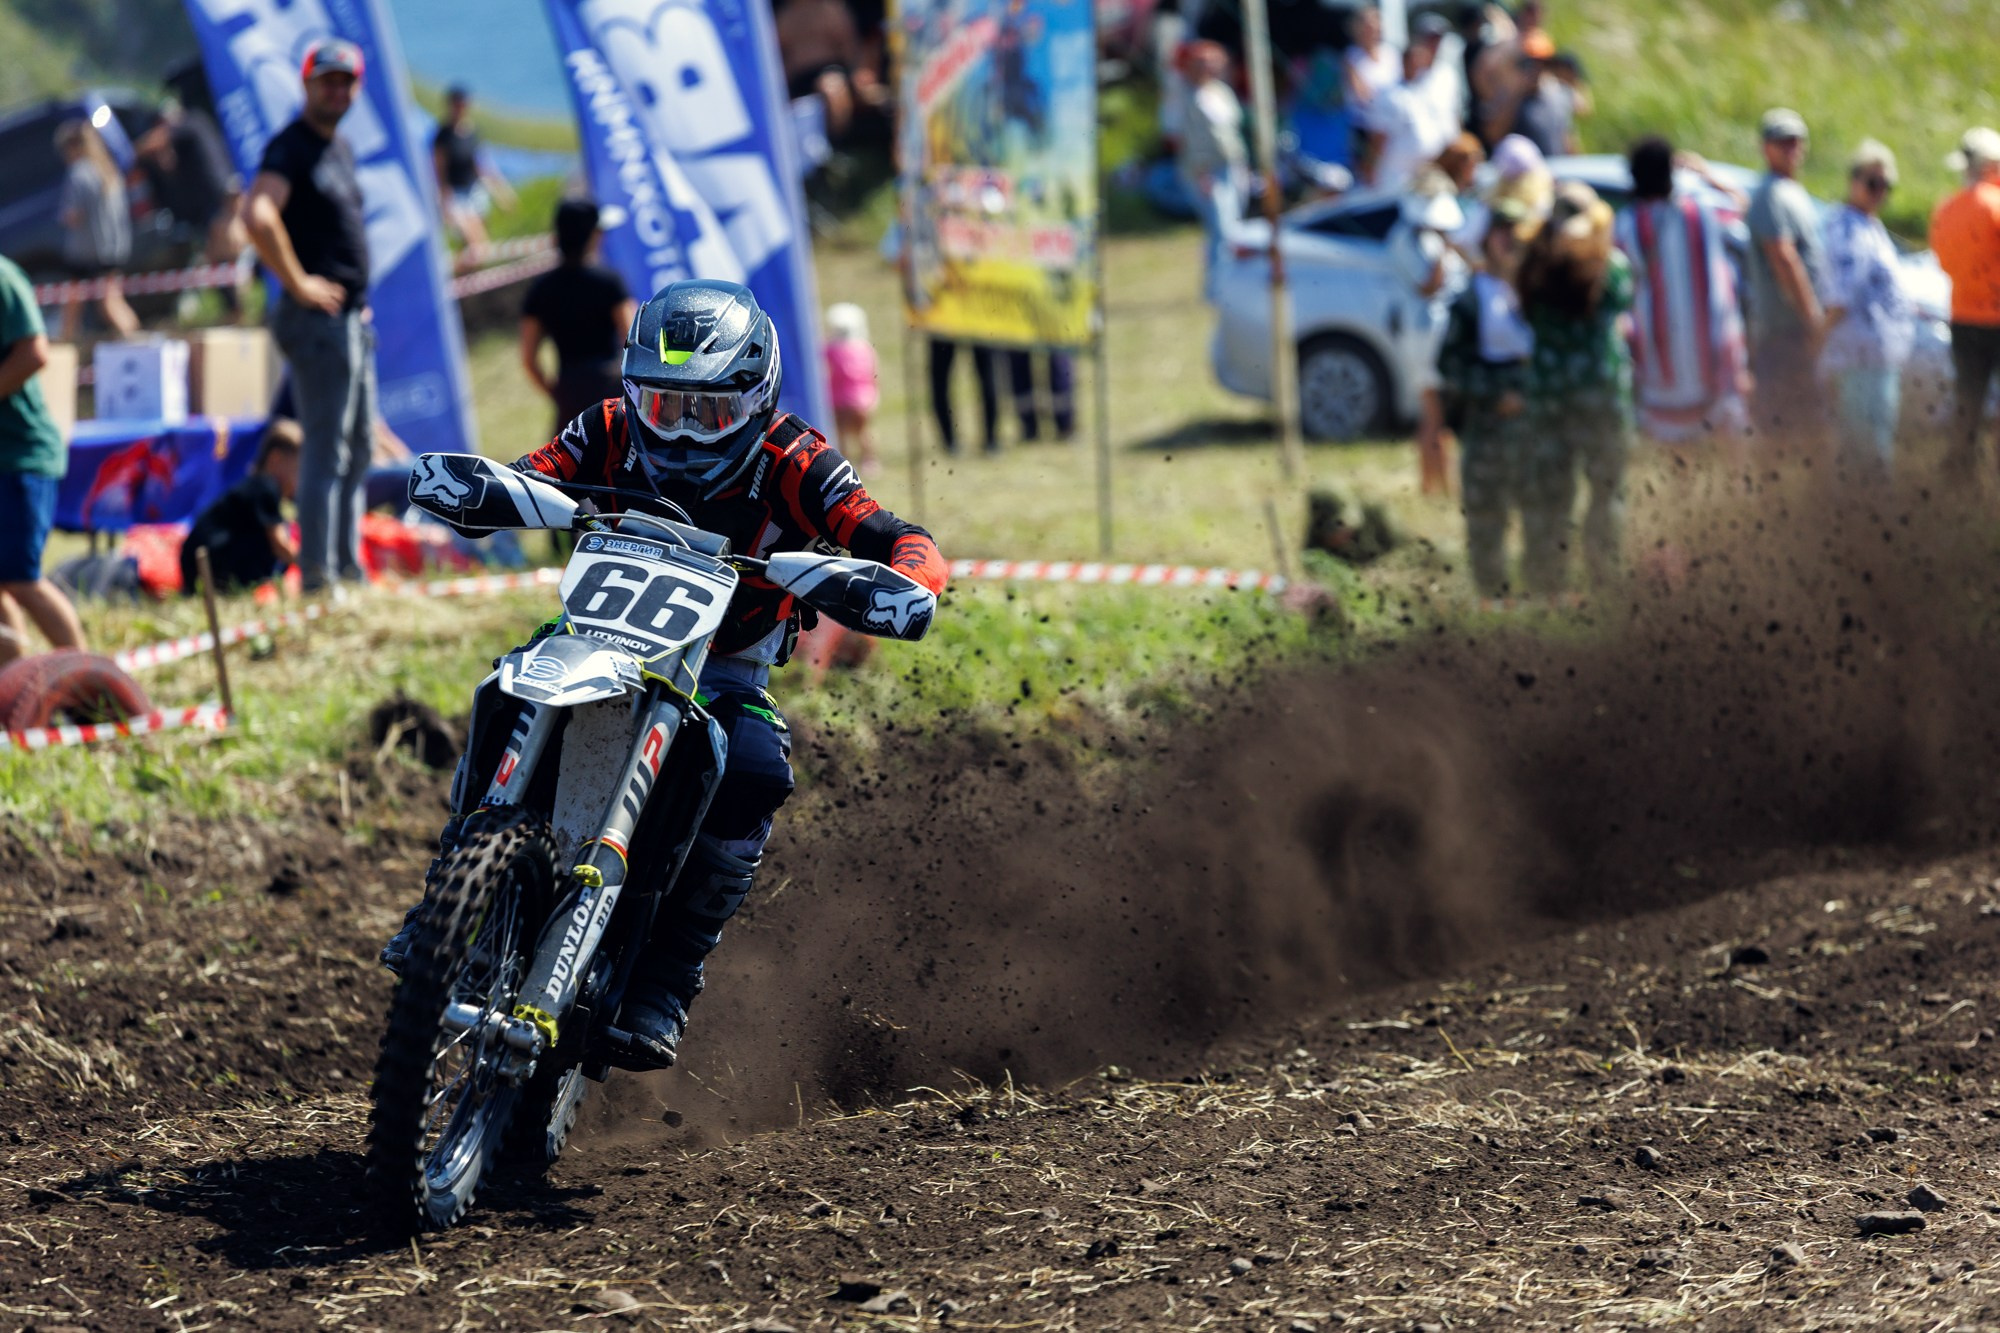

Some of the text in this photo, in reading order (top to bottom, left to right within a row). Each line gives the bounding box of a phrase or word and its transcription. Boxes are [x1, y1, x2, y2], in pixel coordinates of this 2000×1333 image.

[624, 441, 638, 473] OR
[748, 453, 770, 500] THOR
[604, 539, 663, 558] ЭНЕРГИЯ
[565, 561, 714, 642] 66
[586, 629, 652, 652] LITVINOV
[596, 895, 614, 930] DID
[545, 886, 595, 1003] DUNLOP
